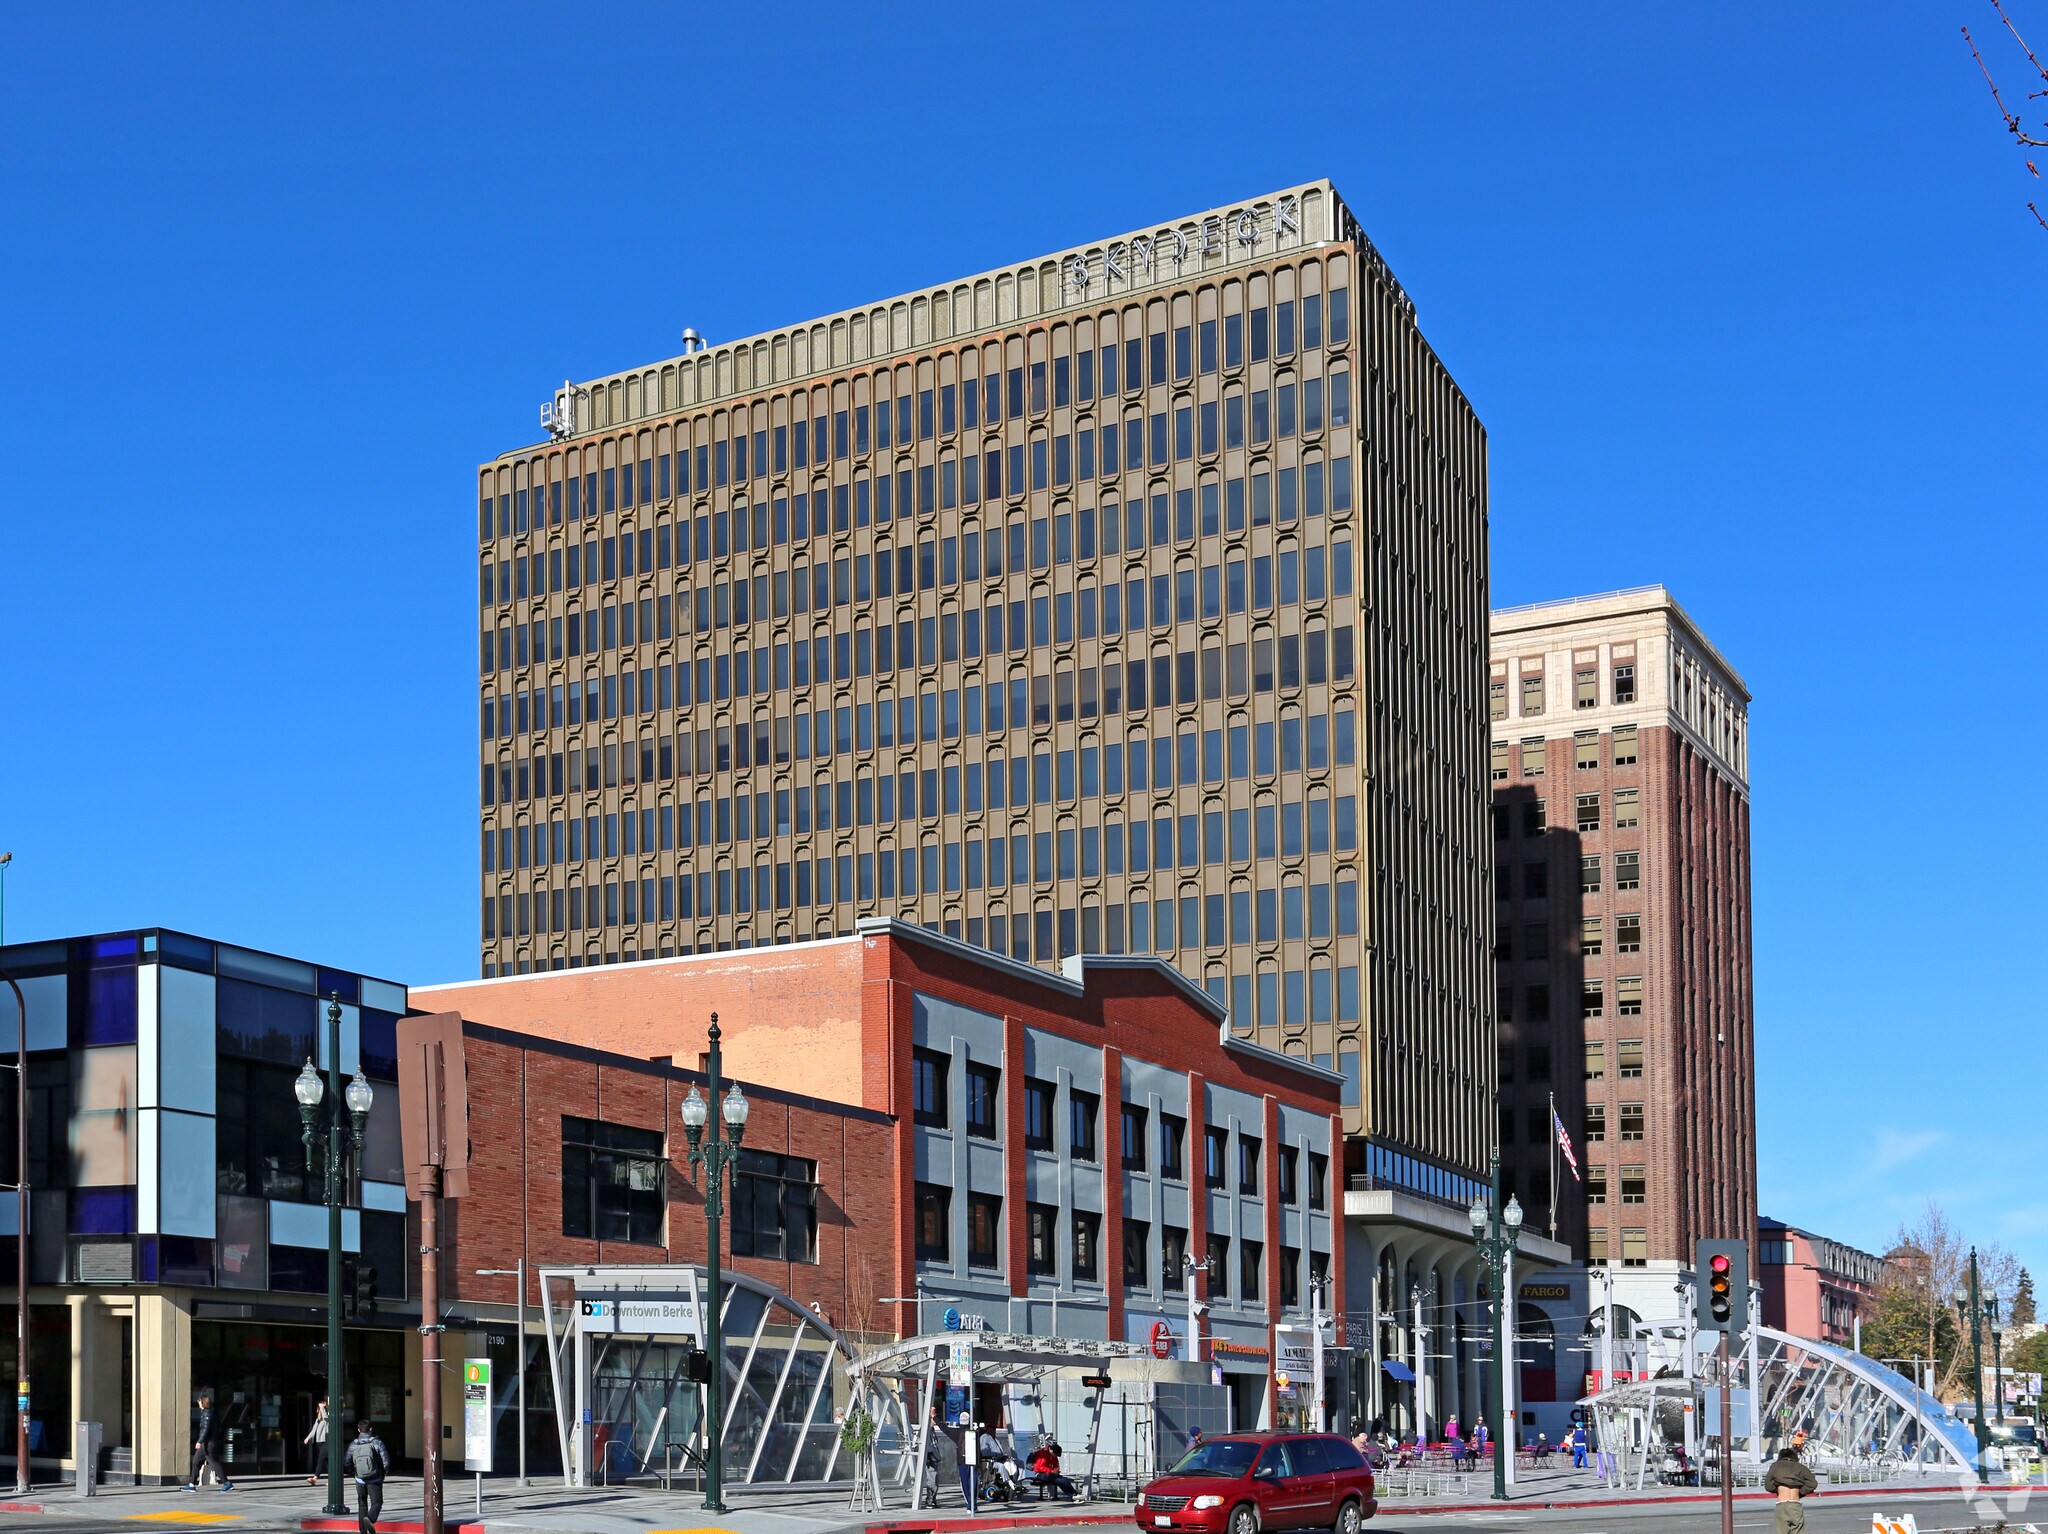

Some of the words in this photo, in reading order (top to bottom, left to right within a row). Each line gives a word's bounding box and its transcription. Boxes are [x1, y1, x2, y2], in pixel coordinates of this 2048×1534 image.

[1071, 195, 1299, 286] SKYDECK
[1524, 1287, 1565, 1296] FARGO
[602, 1304, 660, 1318] Downtown
[662, 1304, 708, 1321] Berkey
[960, 1313, 985, 1331] AT&T
[1346, 1322, 1363, 1335] PARIS
[488, 1335, 505, 1345] 2190
[1346, 1333, 1371, 1347] BAGUETTE
